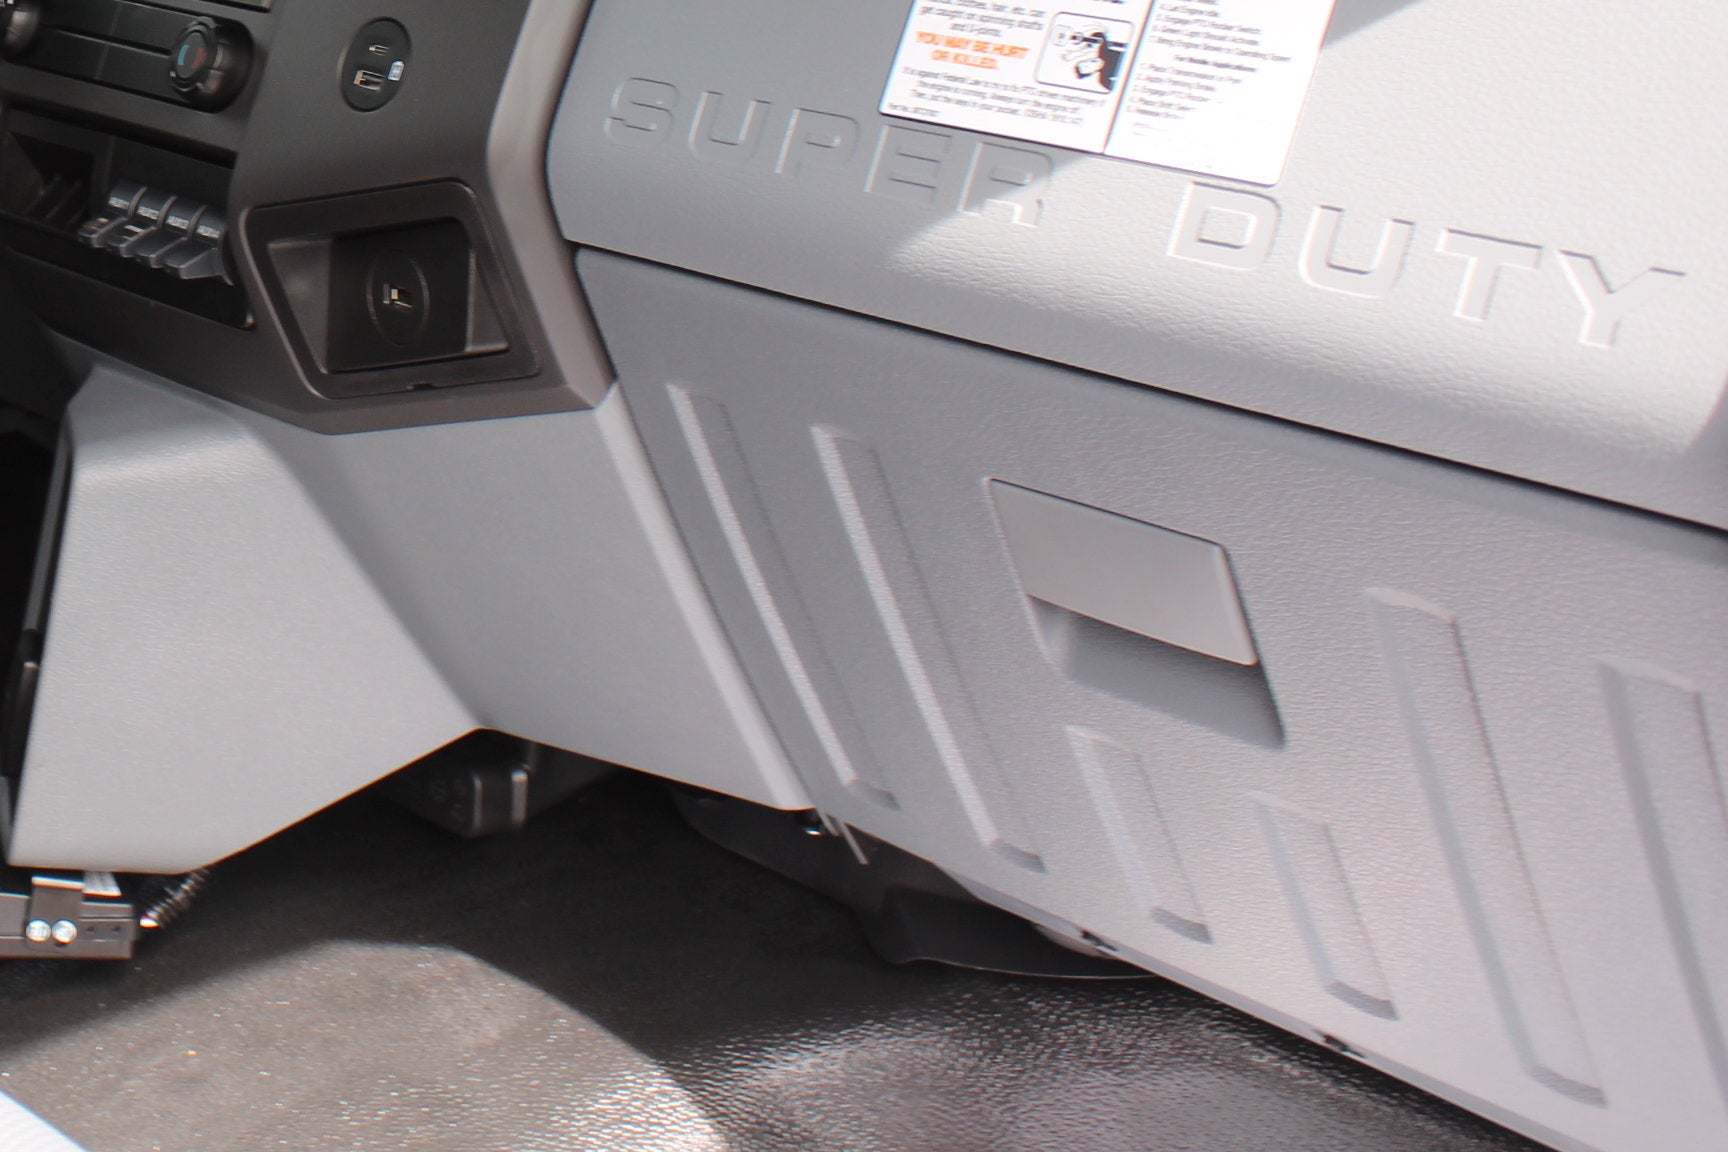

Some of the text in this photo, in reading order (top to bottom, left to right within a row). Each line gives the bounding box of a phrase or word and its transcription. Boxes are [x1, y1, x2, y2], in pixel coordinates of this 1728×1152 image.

[913, 29, 1030, 59] YOU MAY BE HURT
[929, 47, 951, 62] OR
[604, 75, 1688, 349] SUPER DUTY
